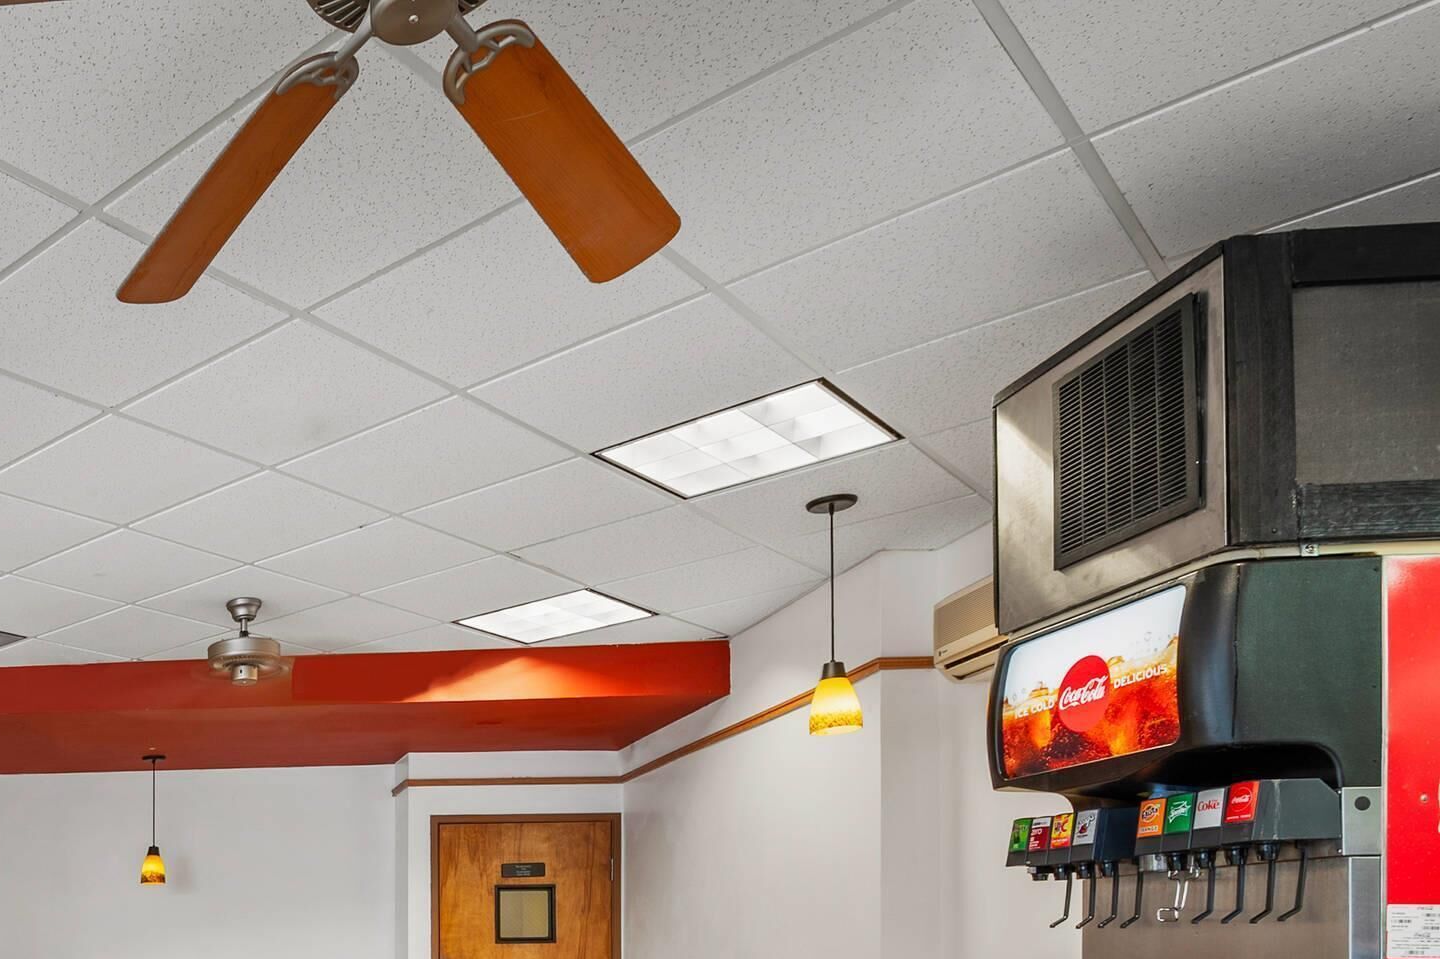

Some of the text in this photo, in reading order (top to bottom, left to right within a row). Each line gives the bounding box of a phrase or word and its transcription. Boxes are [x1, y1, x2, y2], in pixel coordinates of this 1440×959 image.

[1113, 664, 1169, 689] DELICIOUS
[1058, 675, 1108, 710] Coca-Cola
[1015, 699, 1055, 719] ICE COLD
[1197, 800, 1220, 812] Coke
